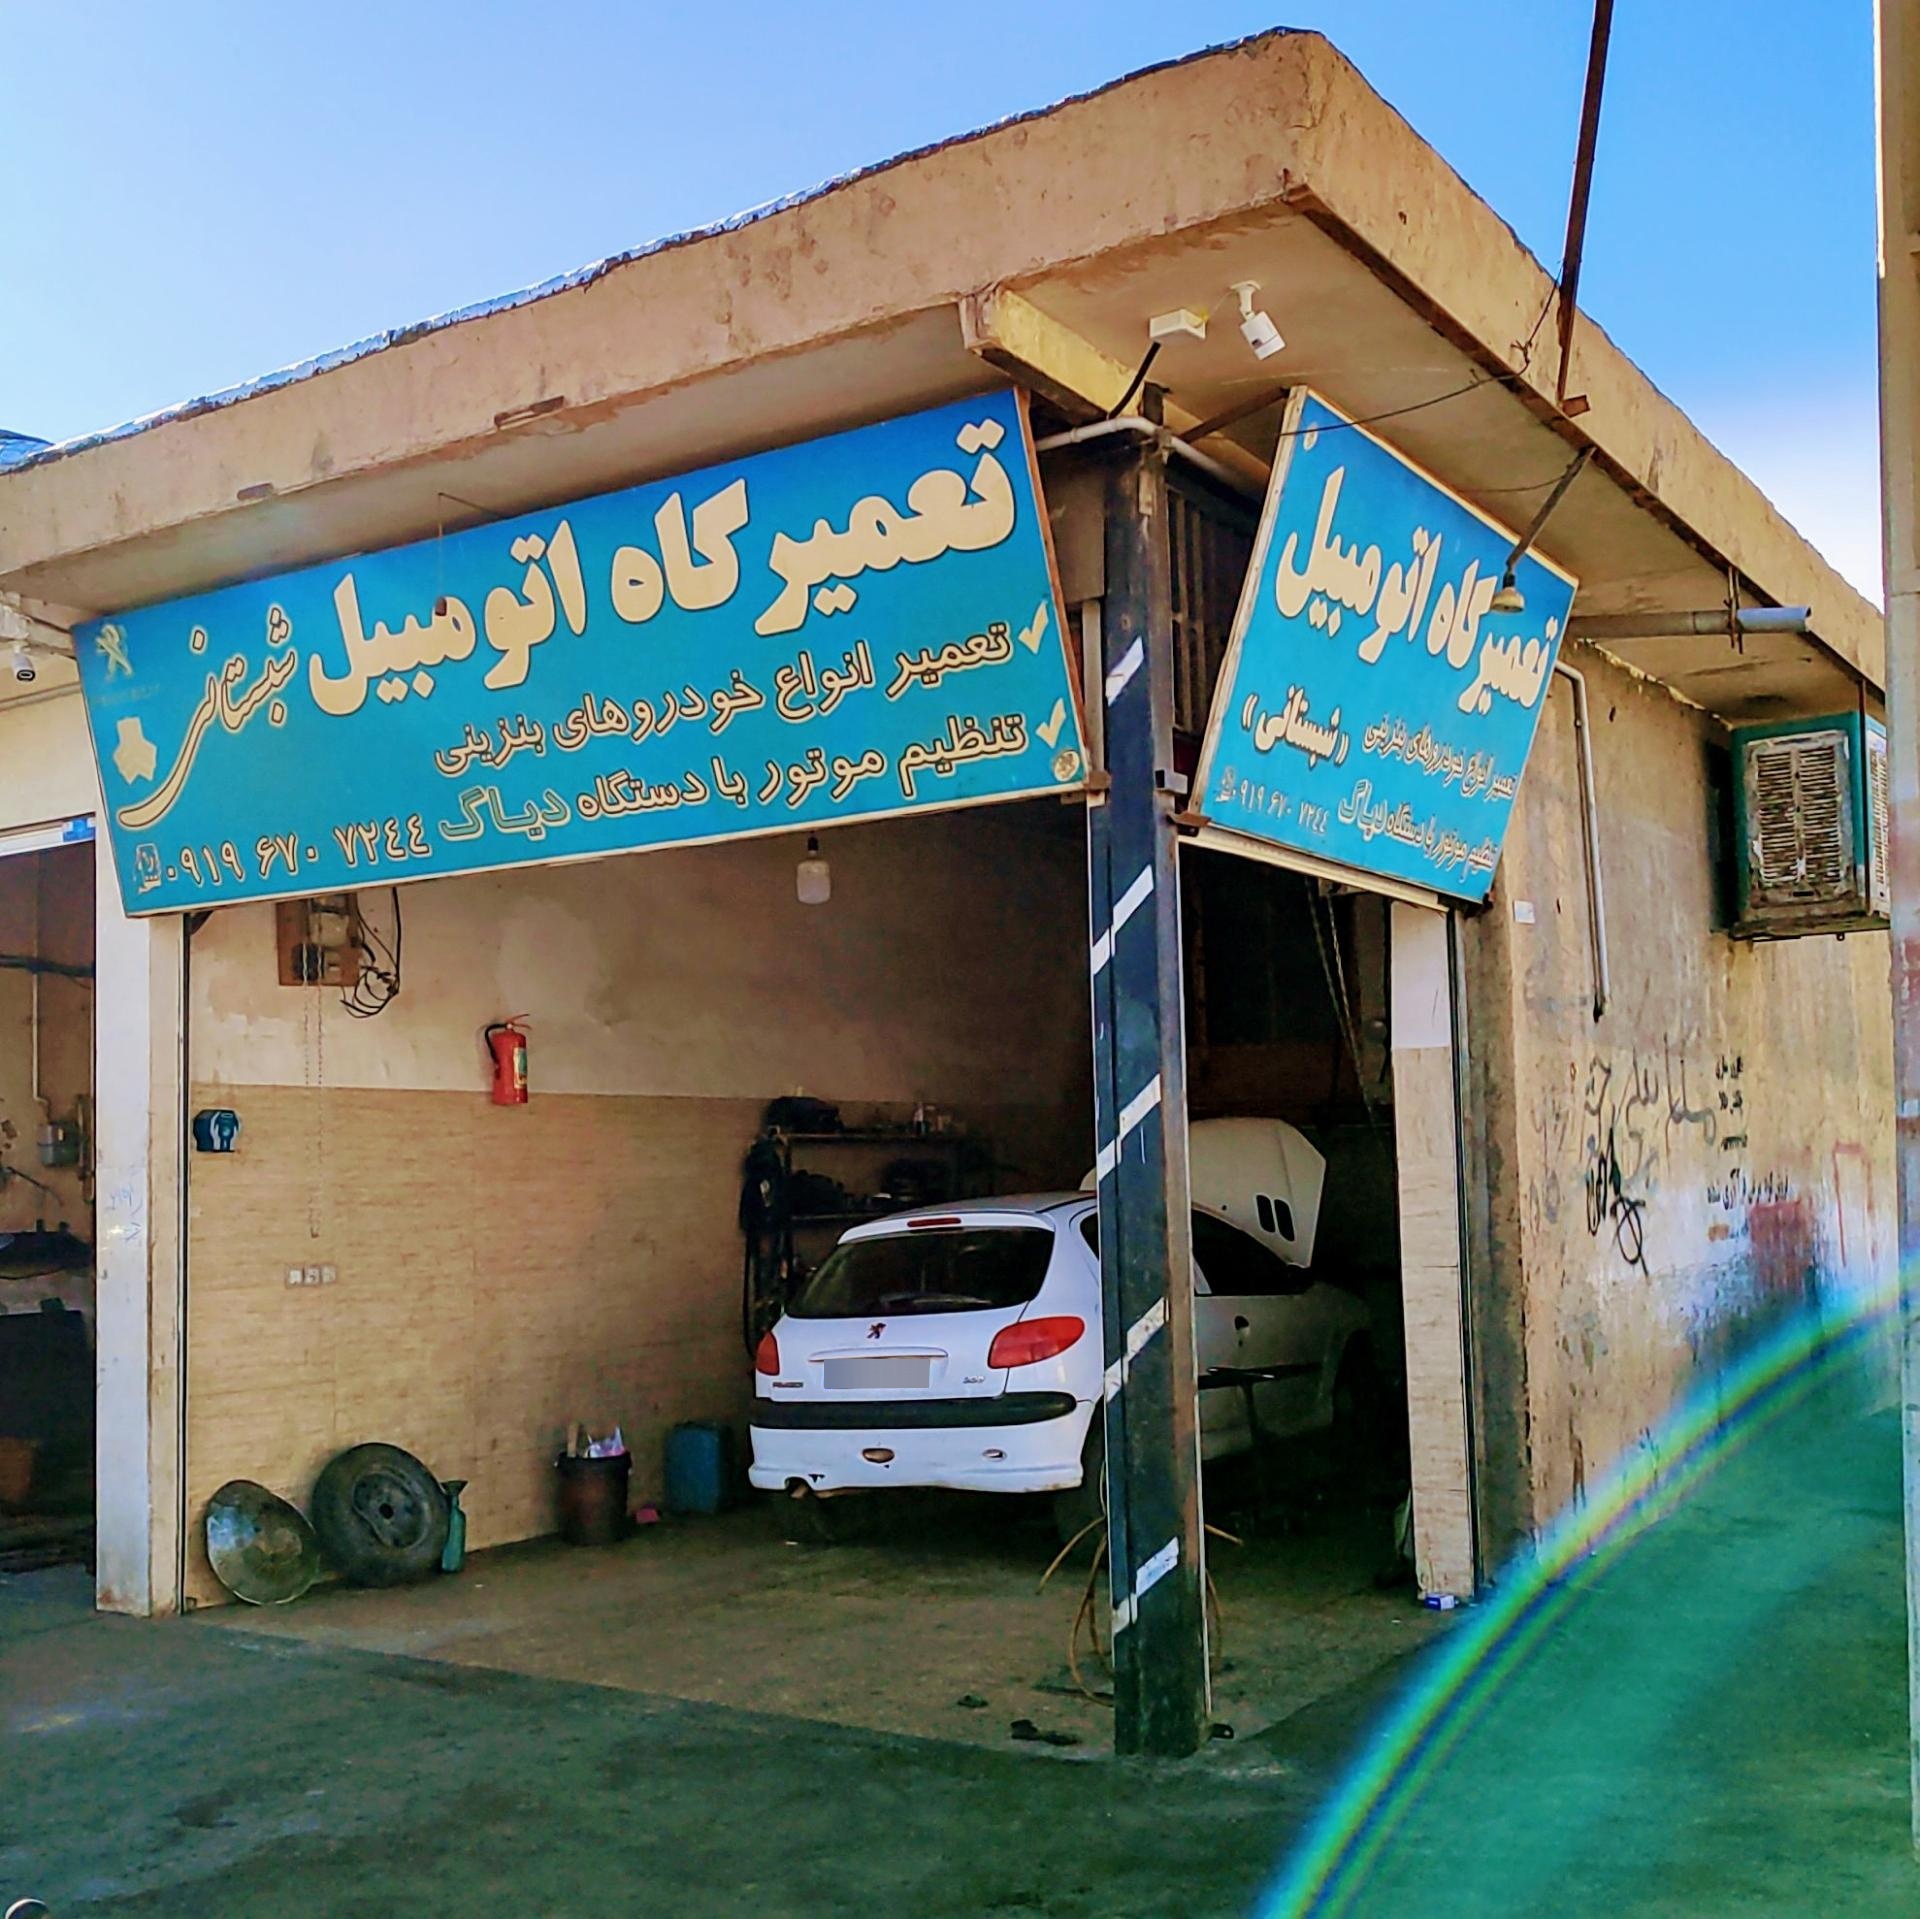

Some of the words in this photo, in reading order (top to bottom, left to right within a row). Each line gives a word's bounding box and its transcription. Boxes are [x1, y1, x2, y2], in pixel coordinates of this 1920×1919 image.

[611, 417, 1016, 637] تعمیرگاه
[1276, 465, 1442, 664] اتومبیل
[307, 519, 587, 716] اتومبیل
[774, 638, 874, 720] انواع
[886, 620, 1012, 699] تعمیر
[116, 603, 299, 830] شبستانی
[551, 668, 766, 749] خودروهای
[1362, 713, 1407, 760] بنزینی
[434, 712, 544, 776] بنزینی
[757, 742, 886, 807] موتور
[899, 711, 1029, 800] تنظیم
[1461, 750, 1495, 797] انواع
[439, 785, 571, 839] دیاگ
[576, 766, 708, 820] دستگاه
[710, 755, 747, 809] با
[1385, 801, 1426, 848] دستگاه
[1430, 827, 1468, 872] موتور
